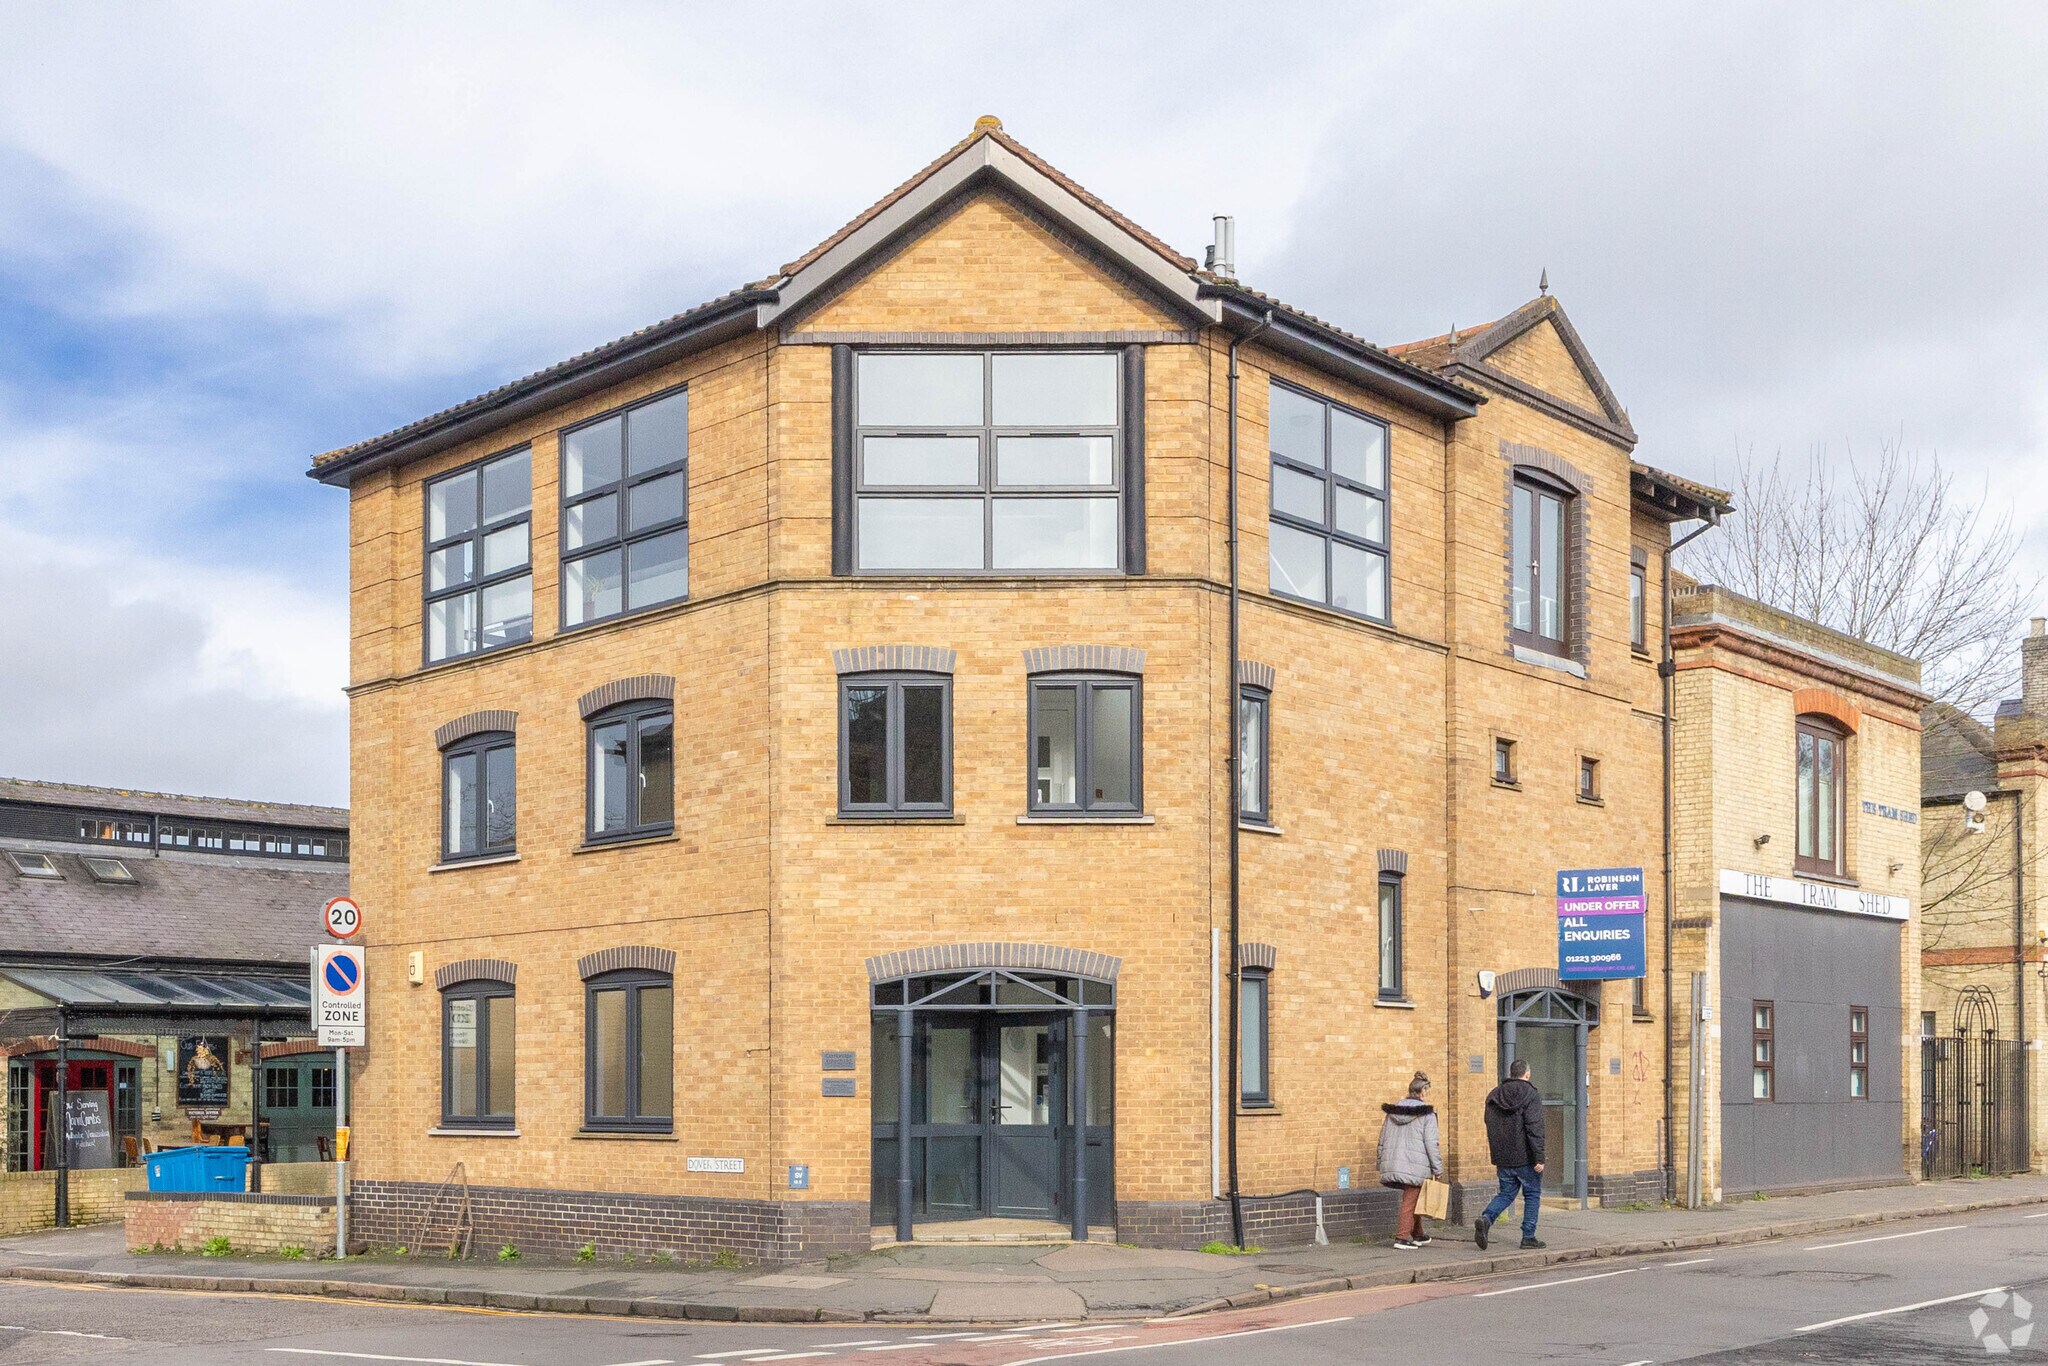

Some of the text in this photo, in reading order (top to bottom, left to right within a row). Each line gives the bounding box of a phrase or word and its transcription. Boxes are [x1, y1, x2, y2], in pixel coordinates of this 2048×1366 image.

[1587, 874, 1640, 883] ROBINSON
[1744, 873, 1891, 915] THE TRAM SHED
[1564, 900, 1640, 912] UNDER OFFER
[331, 909, 356, 925] 20
[1563, 917, 1588, 928] ALL
[1564, 929, 1631, 941] ENQUIRIES
[1565, 953, 1622, 963] 01223 300966
[322, 1001, 362, 1009] Controlled
[324, 1010, 359, 1021] ZONE
[688, 1159, 742, 1170] DOVER STREET
